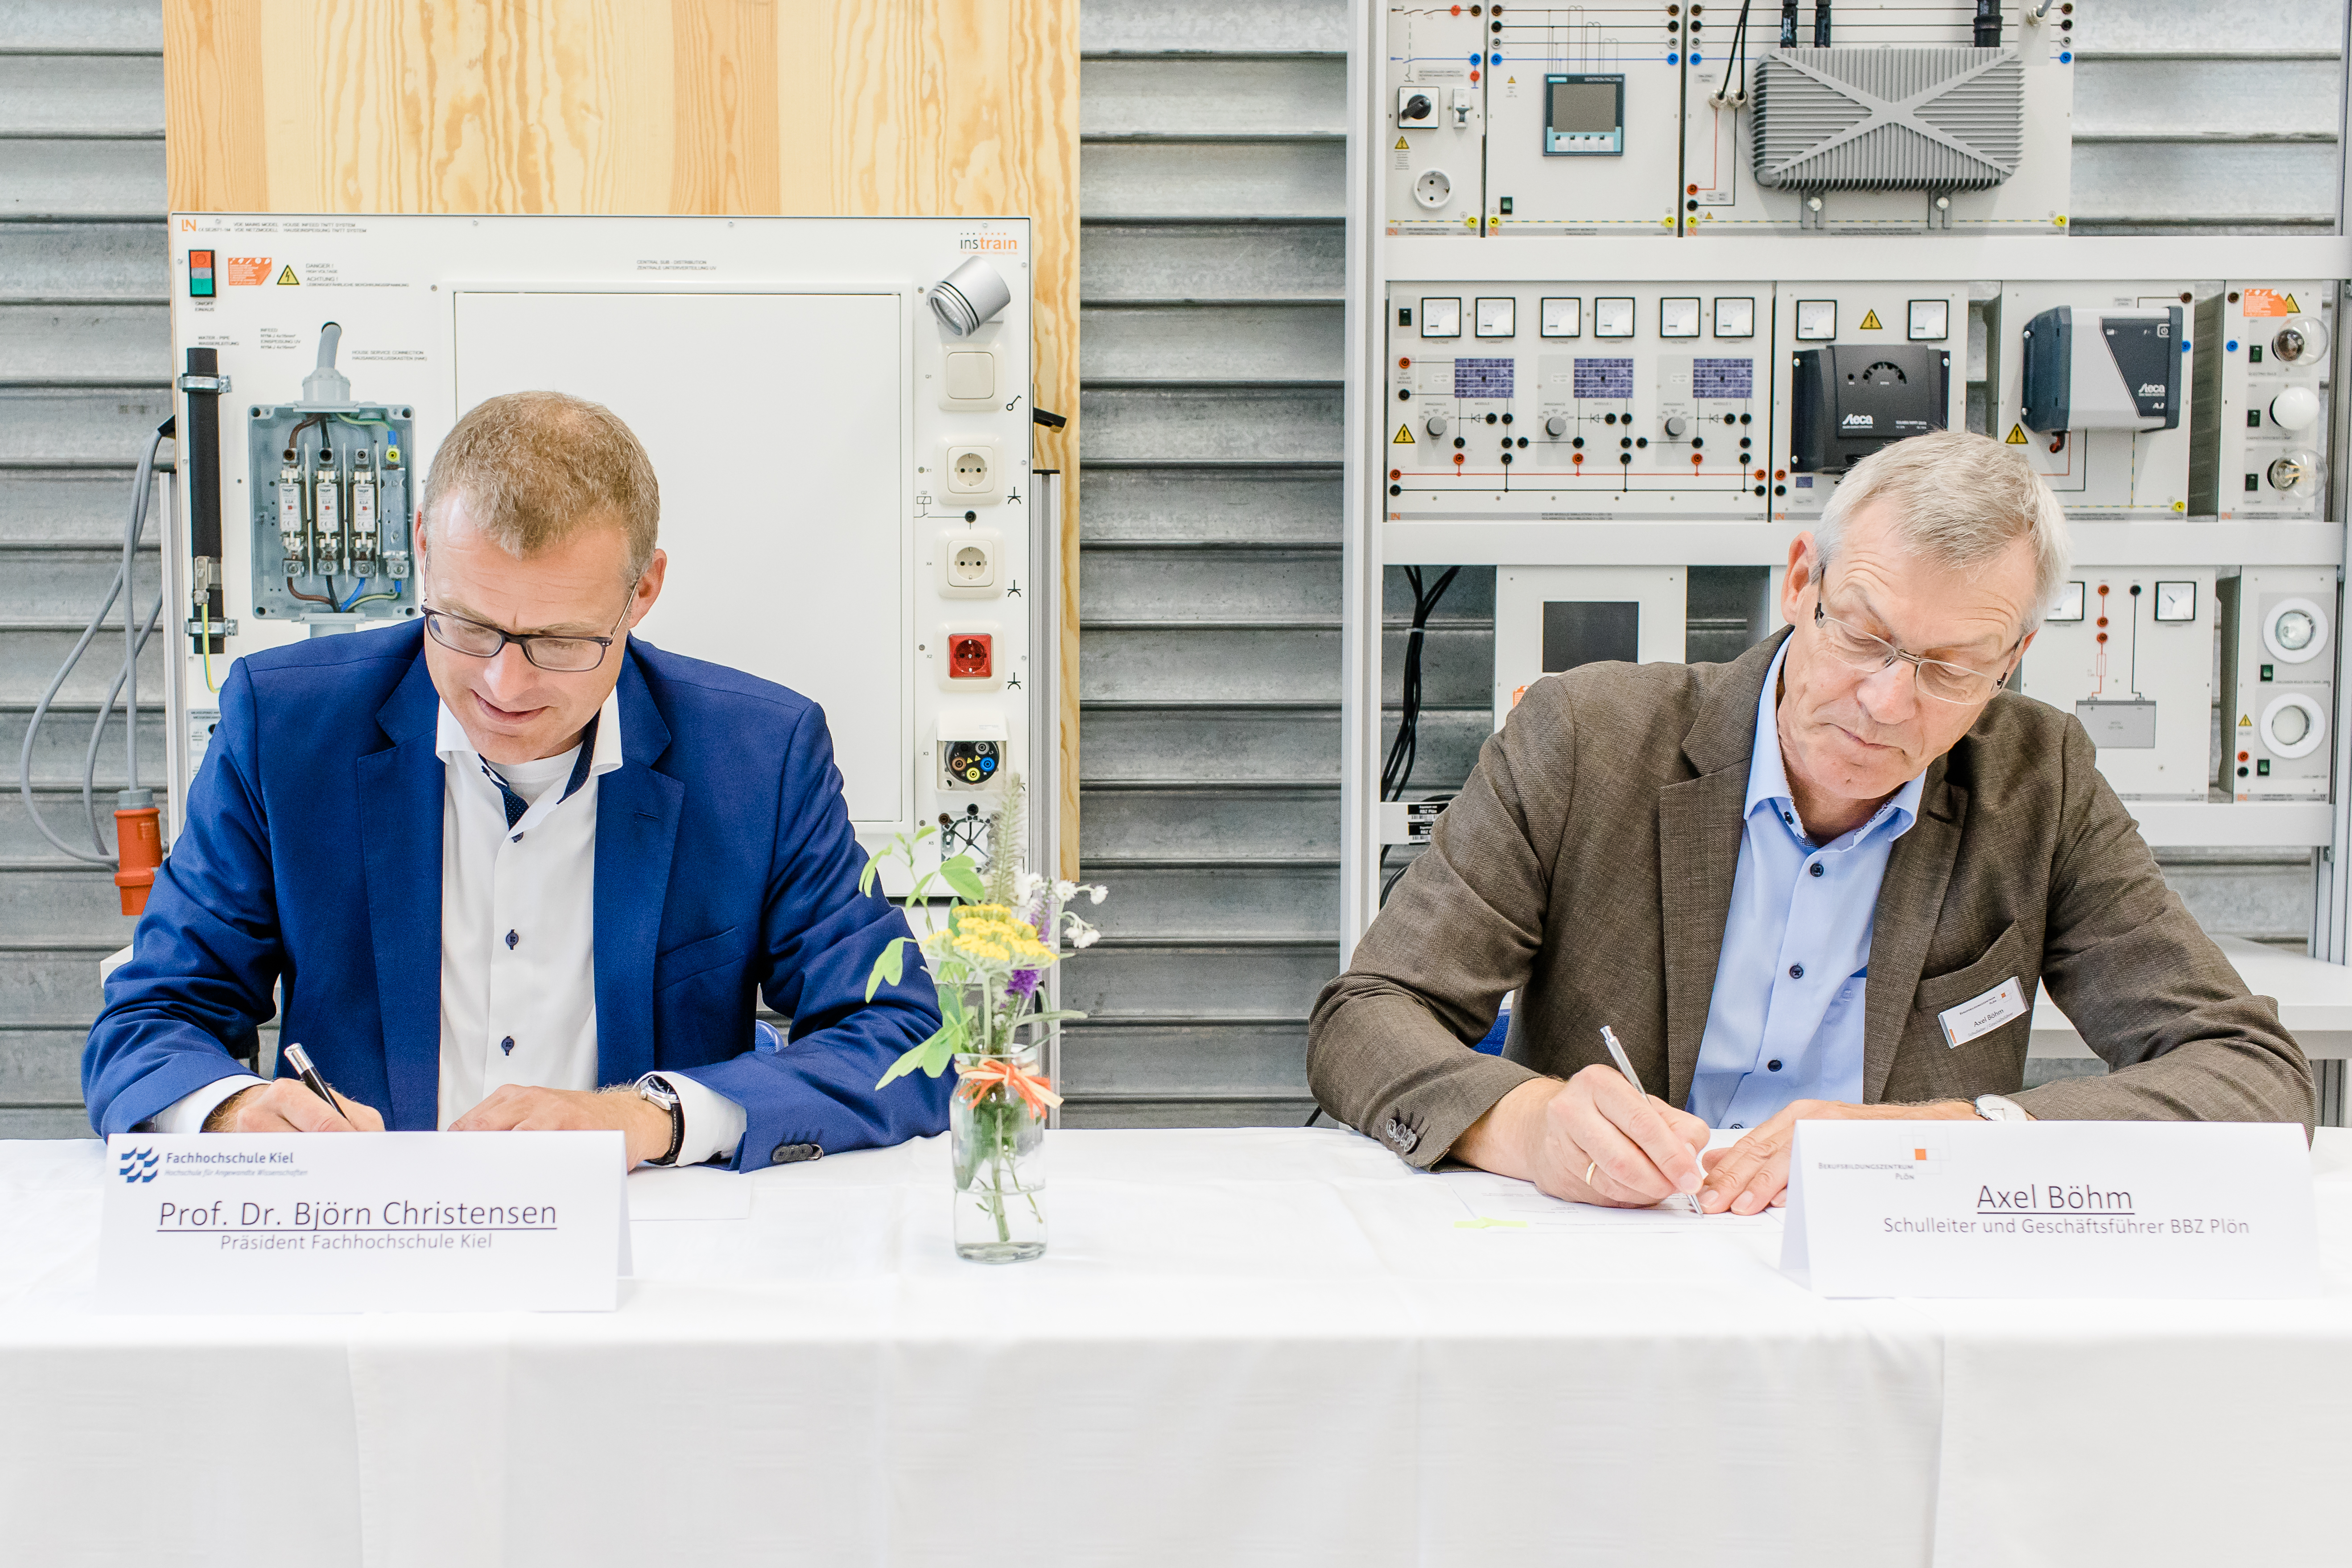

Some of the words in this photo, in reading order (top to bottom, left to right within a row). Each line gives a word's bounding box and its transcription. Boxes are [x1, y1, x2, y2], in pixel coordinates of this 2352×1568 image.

[960, 237, 1017, 249] instrain
[1974, 1017, 1986, 1027] Axel
[1988, 1009, 2004, 1020] Böhm
[1968, 1027, 1986, 1037] Schulleiter
[167, 1153, 266, 1163] Fachhochschule
[269, 1152, 293, 1163] Kiel
[202, 1169, 213, 1177] für
[215, 1169, 255, 1177] Angewandte
[257, 1168, 308, 1176] Wissenschaften
[1977, 1184, 2036, 1209] Axel
[2048, 1184, 2132, 1209] Böhm
[160, 1201, 227, 1226] Prof.
[241, 1202, 281, 1226] Dr.
[294, 1201, 372, 1230] Björn
[384, 1200, 556, 1225] Christensen
[1885, 1218, 1976, 1233] Schulleiter
[1983, 1218, 2015, 1233] und
[2022, 1218, 2164, 1233] Geschäftsführer
[2171, 1219, 2204, 1233] BBZ
[2211, 1219, 2248, 1233] Plön
[221, 1235, 305, 1249] Präsident
[312, 1234, 454, 1249] Fachhochschule
[462, 1234, 491, 1247] Kiel
